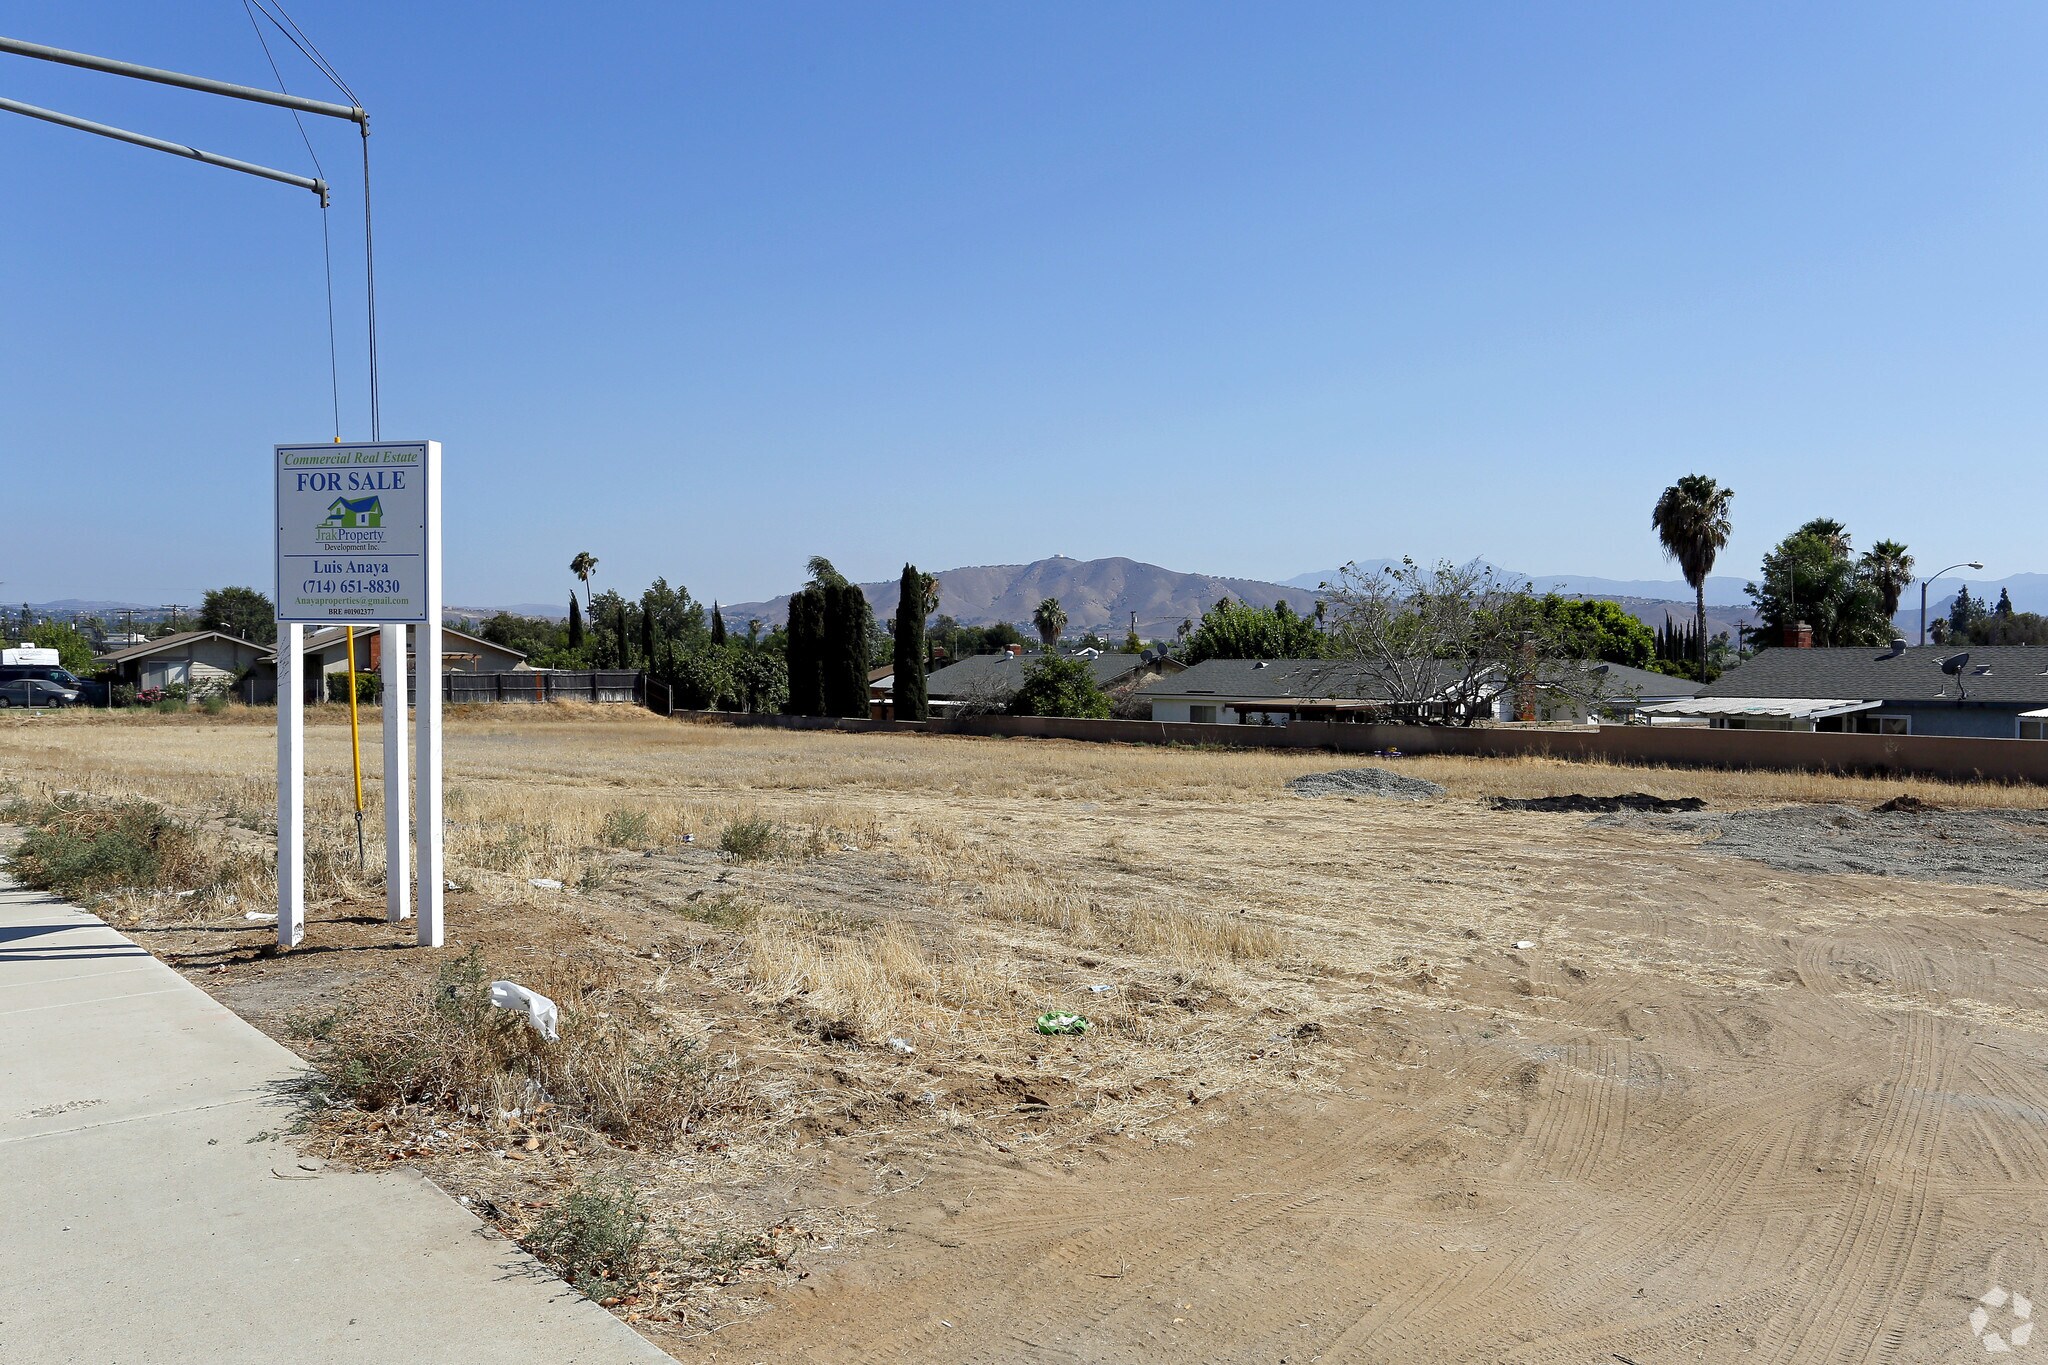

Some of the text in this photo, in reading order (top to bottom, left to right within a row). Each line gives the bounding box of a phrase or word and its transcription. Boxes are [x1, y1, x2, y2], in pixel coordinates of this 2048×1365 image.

[285, 451, 418, 466] Commercial Real Estate
[296, 471, 406, 491] FOR SALE
[324, 543, 380, 553] Development Inc.
[314, 560, 389, 577] Luis Anaya
[303, 579, 400, 594] (714) 651-8830
[295, 596, 409, 606] Anayaproperties@gmail.com
